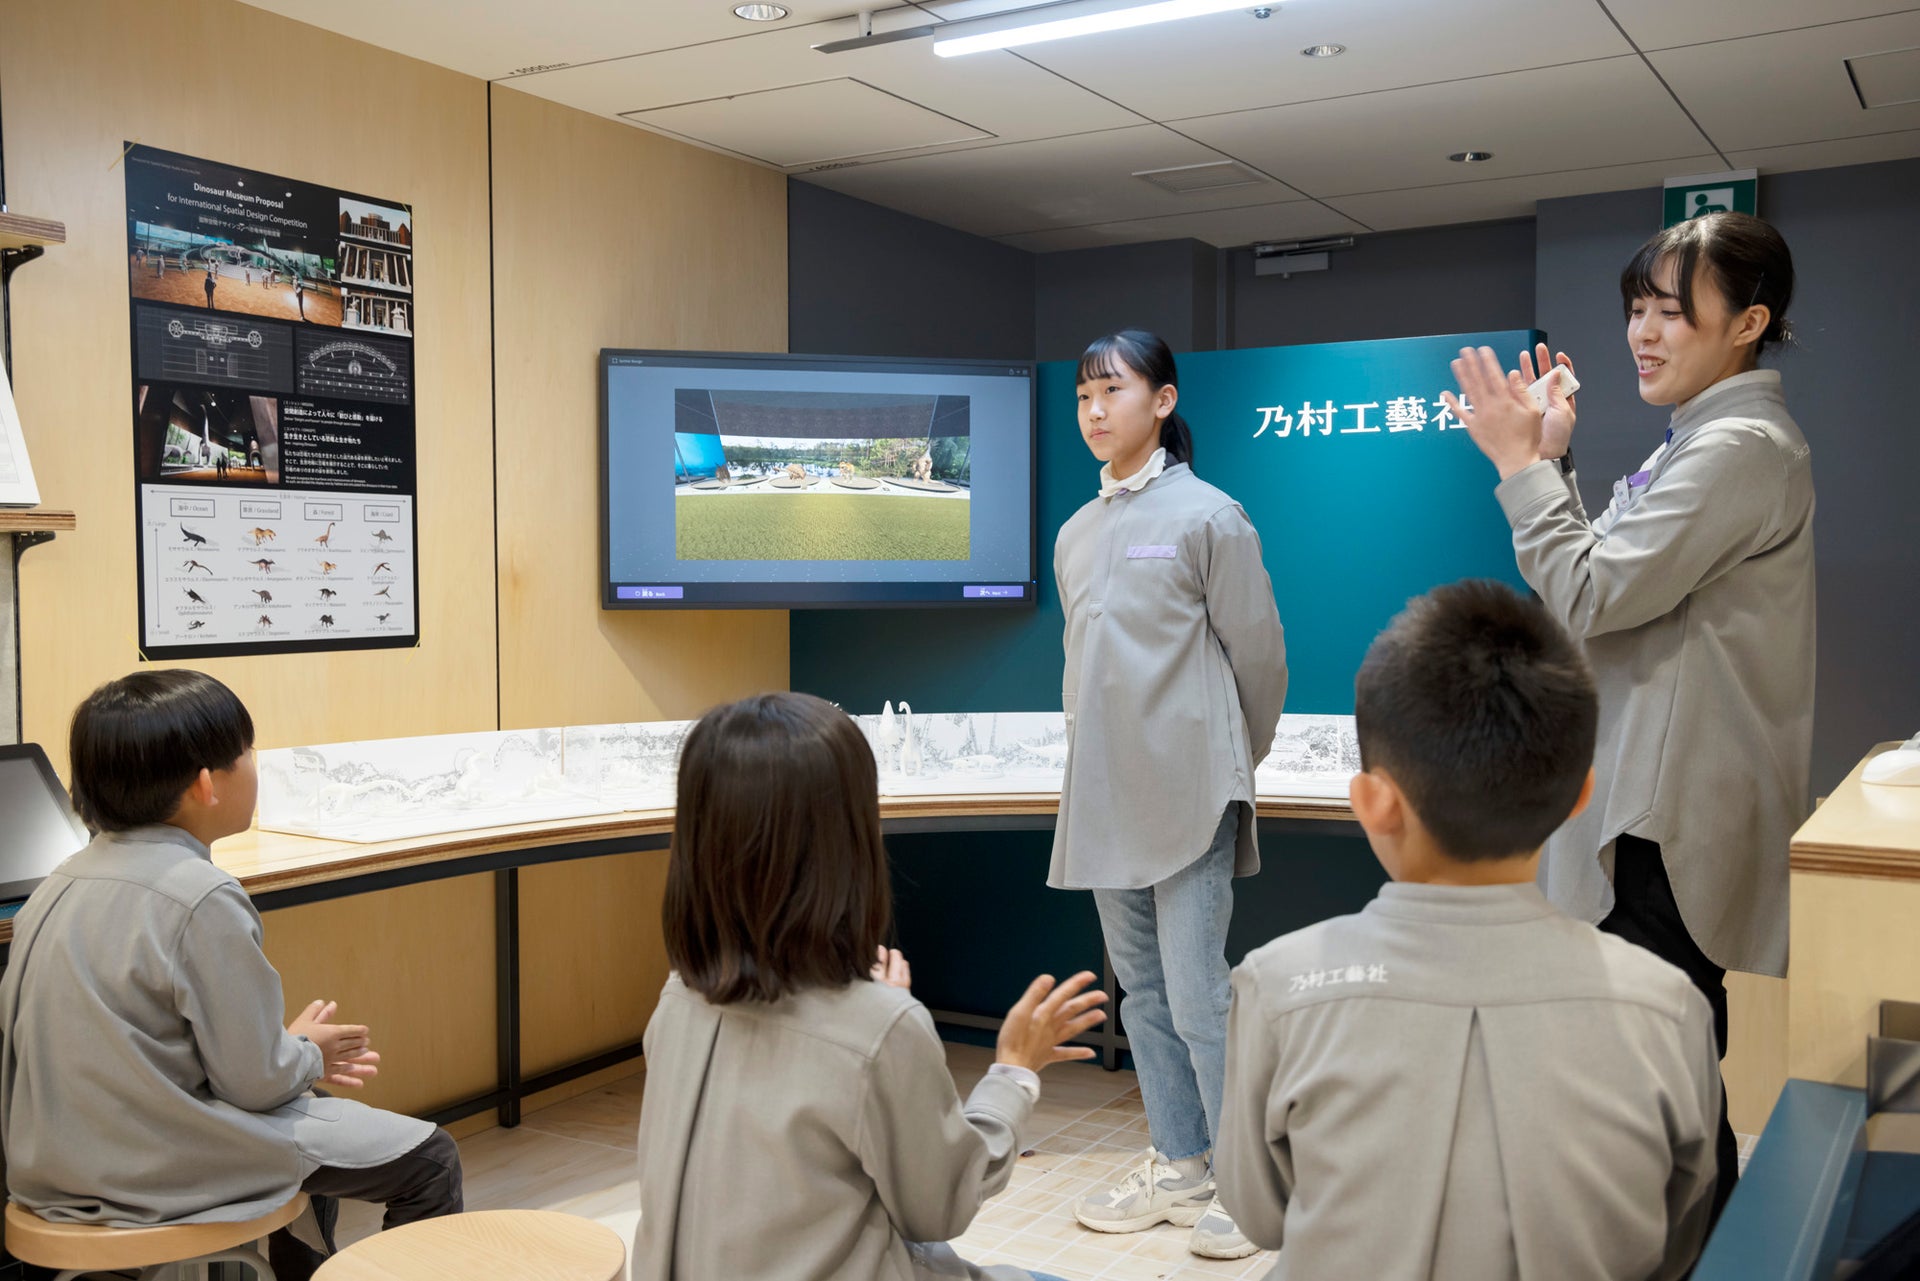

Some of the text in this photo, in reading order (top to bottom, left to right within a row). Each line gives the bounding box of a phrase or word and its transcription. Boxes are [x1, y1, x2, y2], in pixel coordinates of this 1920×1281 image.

[167, 193, 307, 229] for International Spatial Design Competition
[194, 182, 284, 209] Dinosaur Museum Proposal
[1252, 393, 1476, 438] 乃村工藝社
